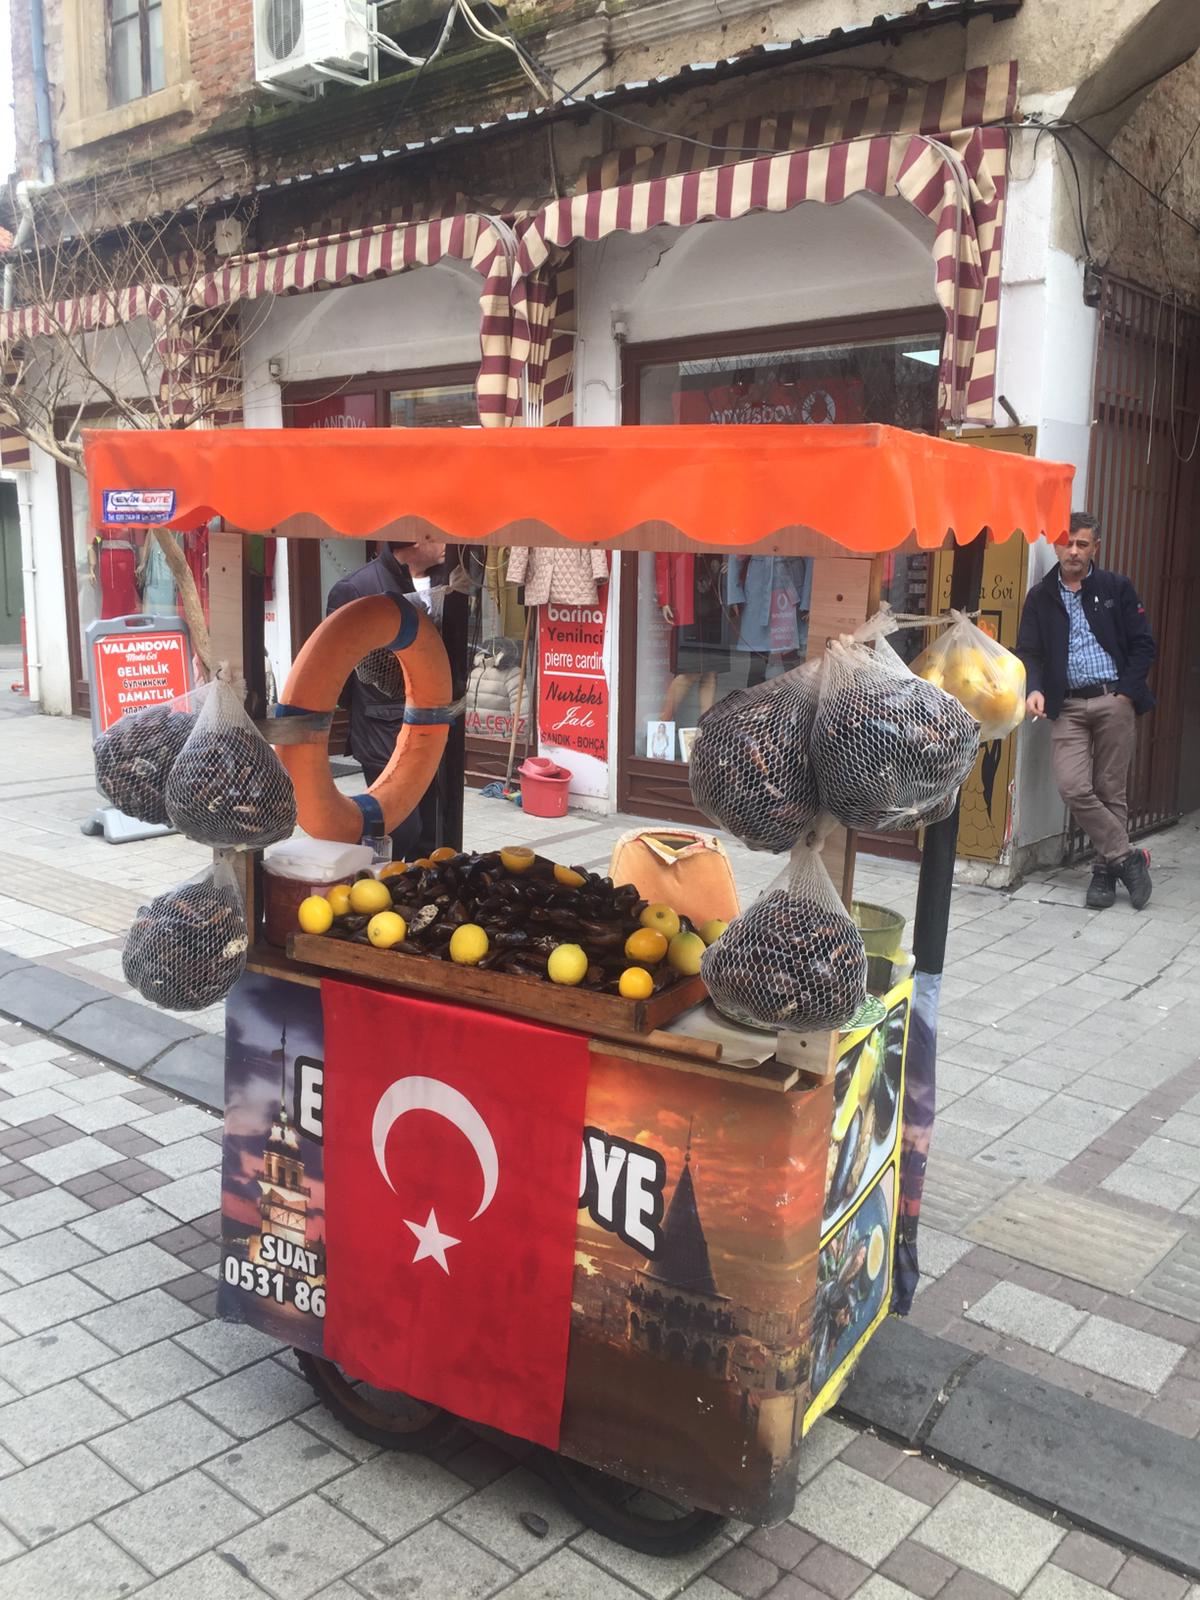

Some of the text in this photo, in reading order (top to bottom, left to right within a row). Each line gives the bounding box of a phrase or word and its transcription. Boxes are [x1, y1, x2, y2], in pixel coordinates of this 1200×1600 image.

[991, 575, 1013, 600] Evi
[548, 603, 603, 624] barina
[102, 640, 179, 654] VALANDOVA
[117, 661, 170, 677] GELİNLİK
[545, 648, 573, 670] pierre
[117, 689, 175, 703] DAMATLIK
[545, 681, 603, 705] Nurteks
[552, 706, 595, 731] Jale
[540, 731, 571, 746] SANDIK
[577, 736, 605, 753] BOHÇA
[579, 1135, 657, 1252] YE
[262, 1232, 318, 1276] SUAT
[224, 1255, 326, 1318] 0531 86
